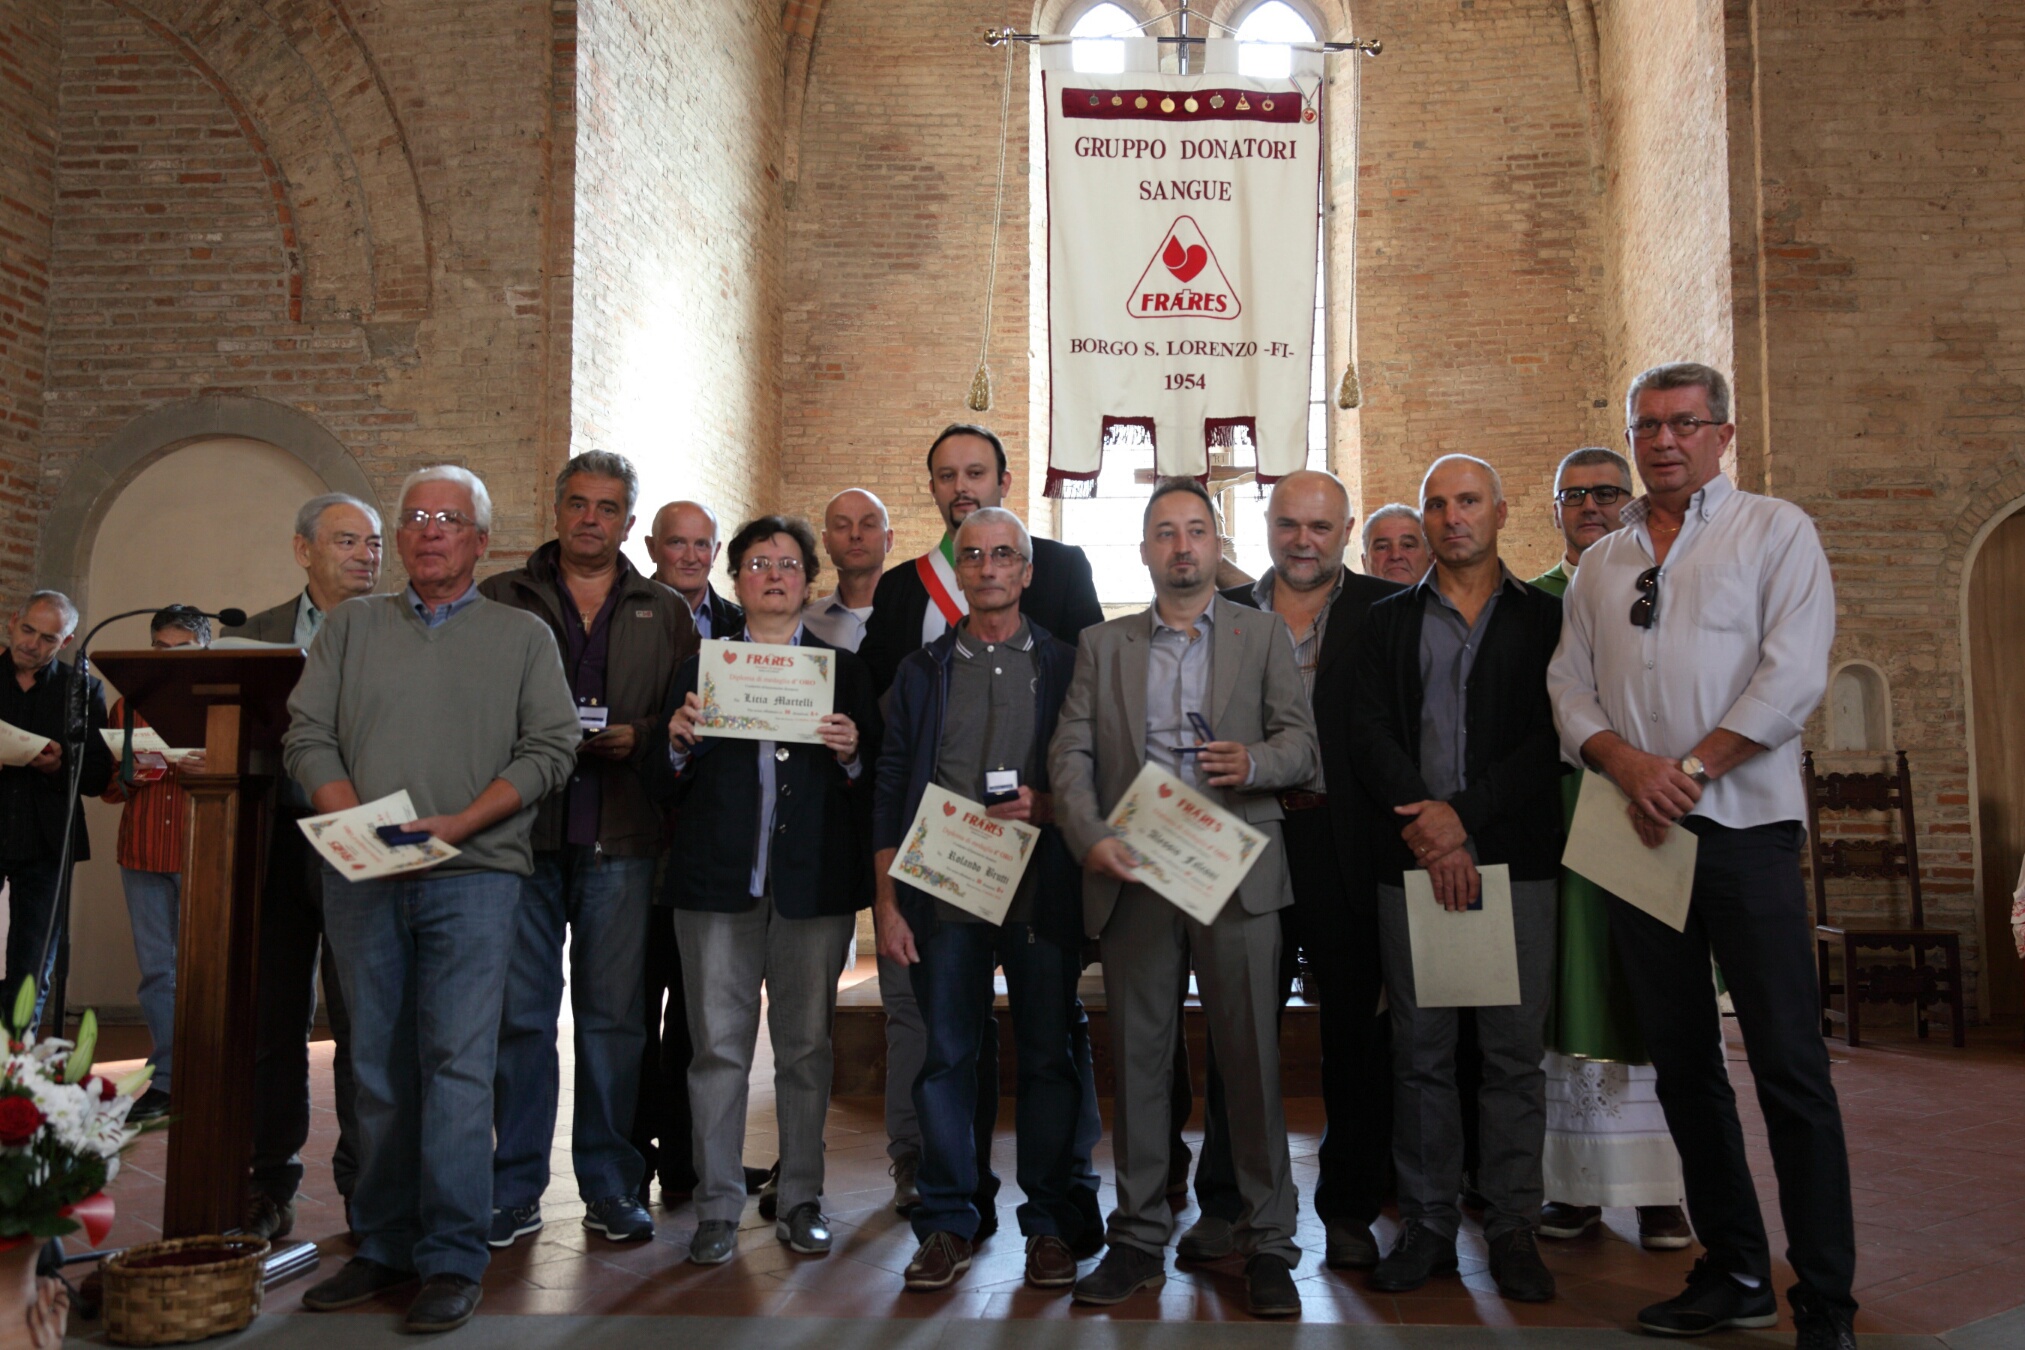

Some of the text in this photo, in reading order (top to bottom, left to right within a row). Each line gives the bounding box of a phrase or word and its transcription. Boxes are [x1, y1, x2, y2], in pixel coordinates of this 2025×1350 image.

[1075, 136, 1297, 160] GRUPPO DONATORI
[1139, 180, 1231, 201] SANGUE
[1070, 338, 1138, 356] BORGO
[1144, 341, 1160, 357] S.
[1167, 340, 1257, 358] LORENZO
[1165, 374, 1206, 391] 1954
[744, 693, 768, 704] Licia
[773, 695, 813, 708] Martelli
[947, 850, 982, 873] Rolando
